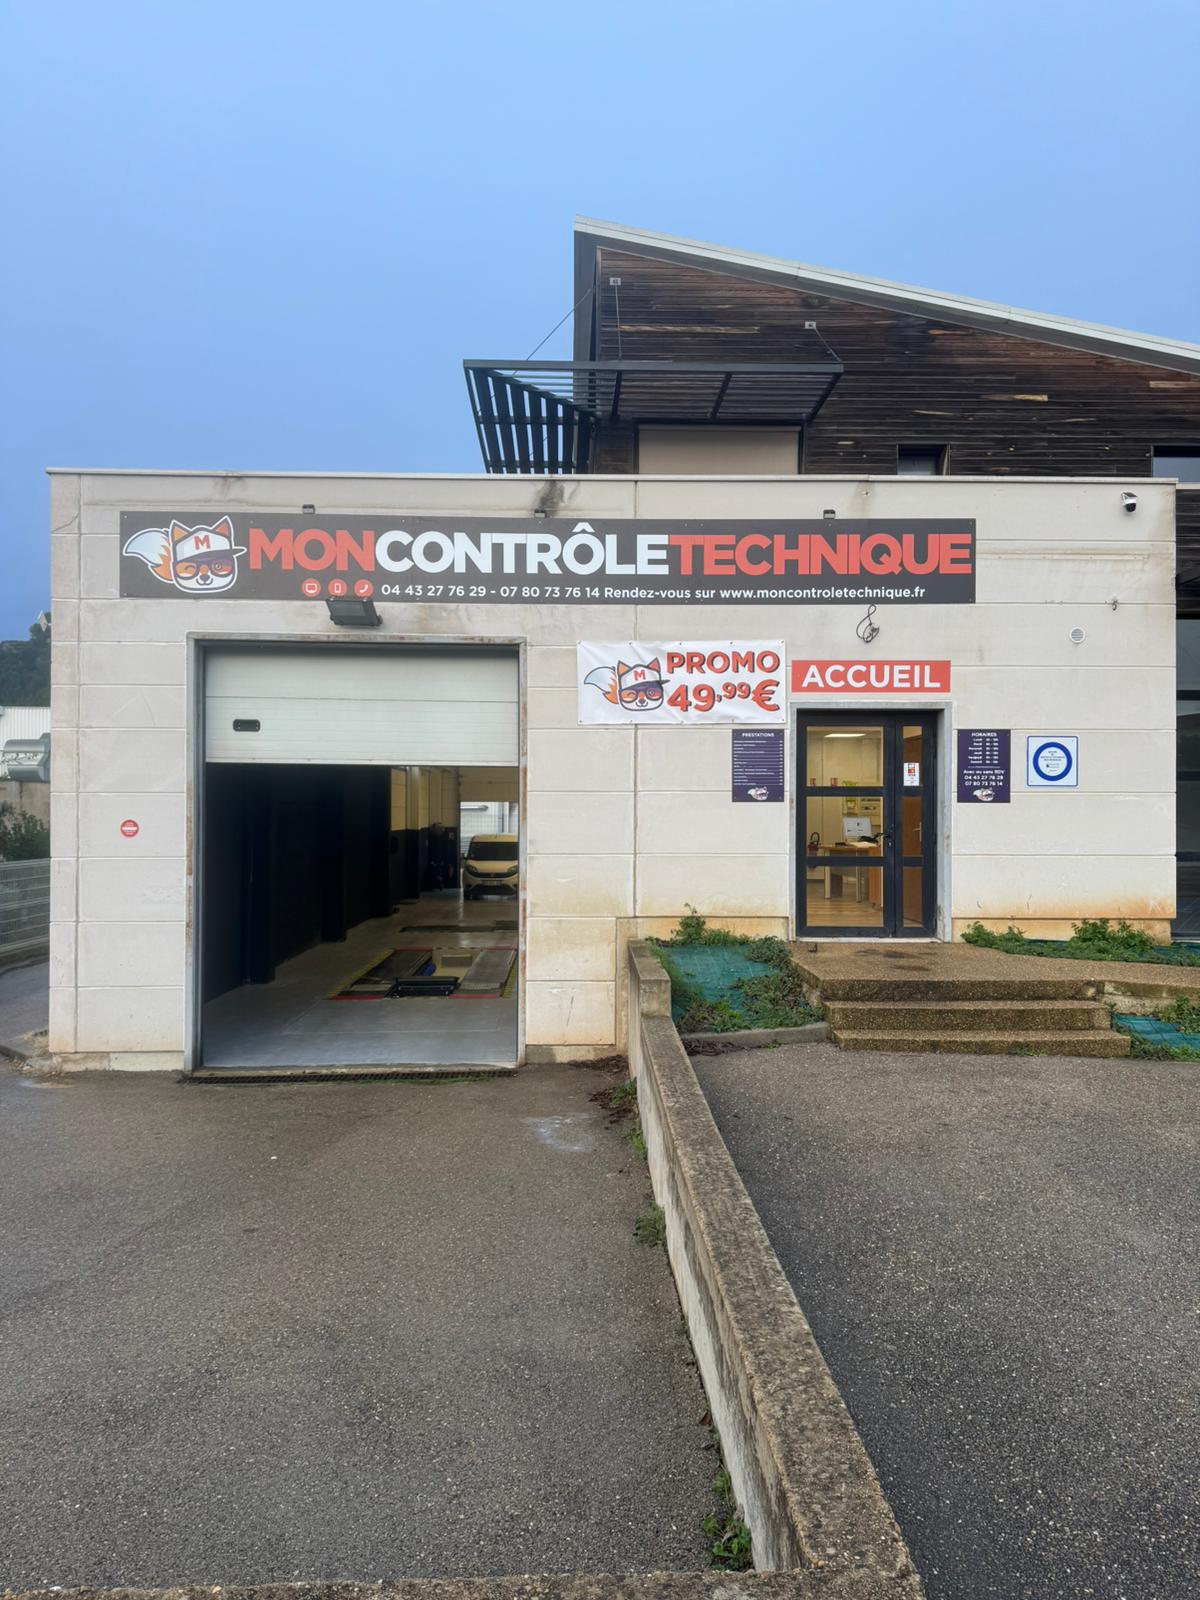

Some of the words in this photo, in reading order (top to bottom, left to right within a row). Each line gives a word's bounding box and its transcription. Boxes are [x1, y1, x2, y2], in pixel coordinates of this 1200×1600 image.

[194, 534, 212, 550] M
[249, 521, 972, 576] MONCONTRÔLETECHNIQUE
[381, 584, 400, 596] 04
[405, 585, 423, 596] 43
[427, 585, 443, 597] 27
[448, 585, 465, 597] 76
[469, 585, 486, 597] 29
[500, 585, 517, 597] 07
[521, 586, 540, 598] 80
[544, 586, 560, 598] 73
[565, 587, 581, 598] 76
[585, 587, 600, 598] 14
[604, 586, 691, 599] Rendez-vous
[695, 589, 715, 599] sur
[719, 586, 926, 600] www.moncontroletechnique.fr
[666, 650, 781, 674] PROMO
[633, 669, 646, 682] M
[802, 664, 941, 689] ACCUEIL
